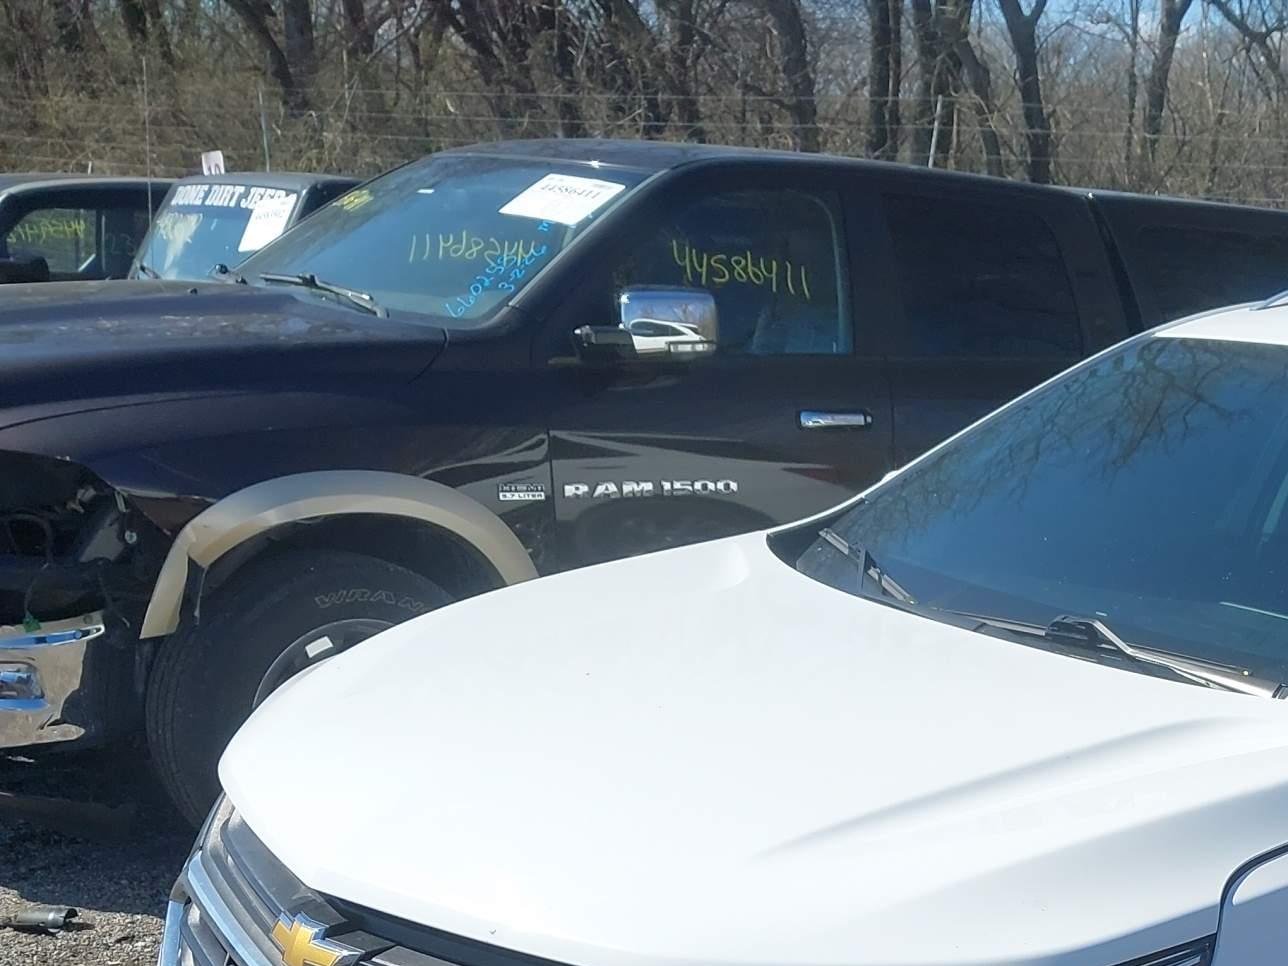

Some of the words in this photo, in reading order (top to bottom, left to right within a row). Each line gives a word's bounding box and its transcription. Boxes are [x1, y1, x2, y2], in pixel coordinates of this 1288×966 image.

[205, 184, 245, 207] DIRT
[672, 239, 811, 299] 44586411
[563, 480, 654, 499] RAM
[660, 479, 738, 496] 1500
